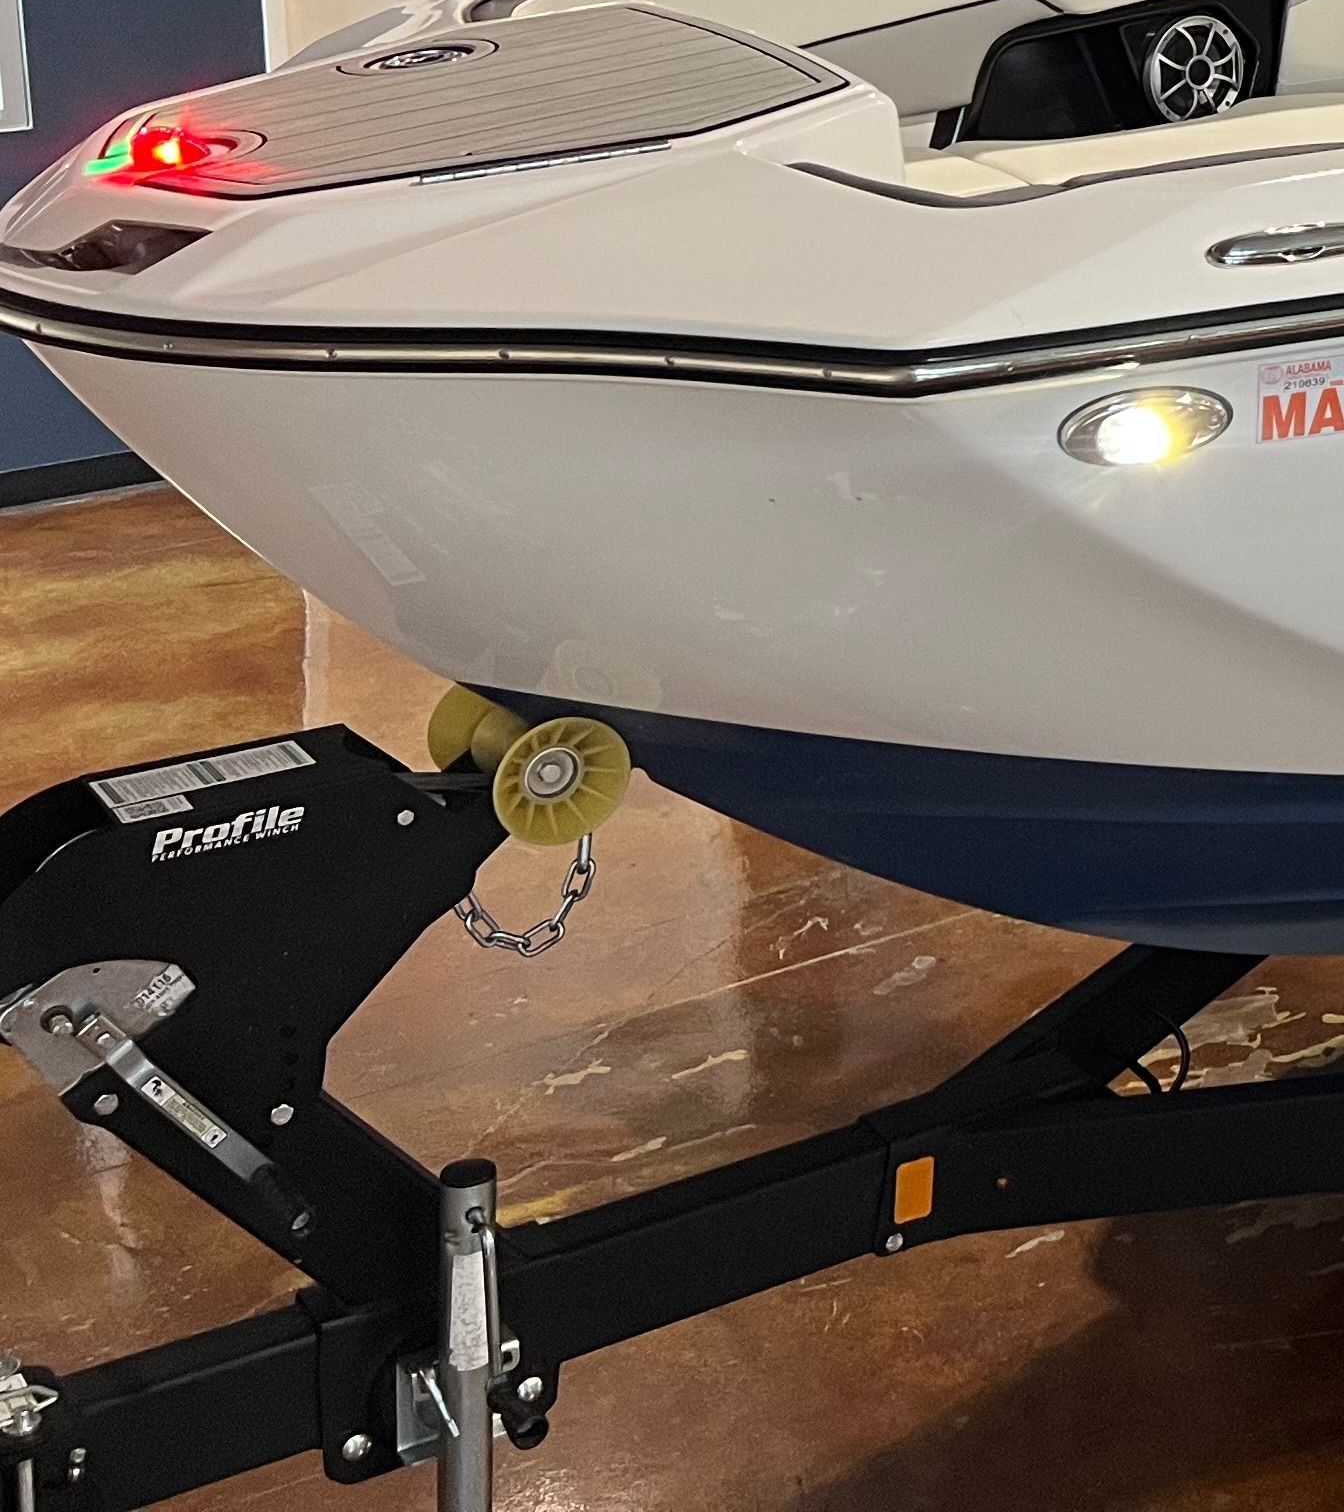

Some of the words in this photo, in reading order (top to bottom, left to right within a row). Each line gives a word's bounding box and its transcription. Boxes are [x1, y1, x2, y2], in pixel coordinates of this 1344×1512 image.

[1285, 360, 1332, 376] ALABAMA
[151, 833, 249, 863] PERFORMANCE
[255, 823, 300, 841] WINCH
[152, 805, 305, 856] Profile
